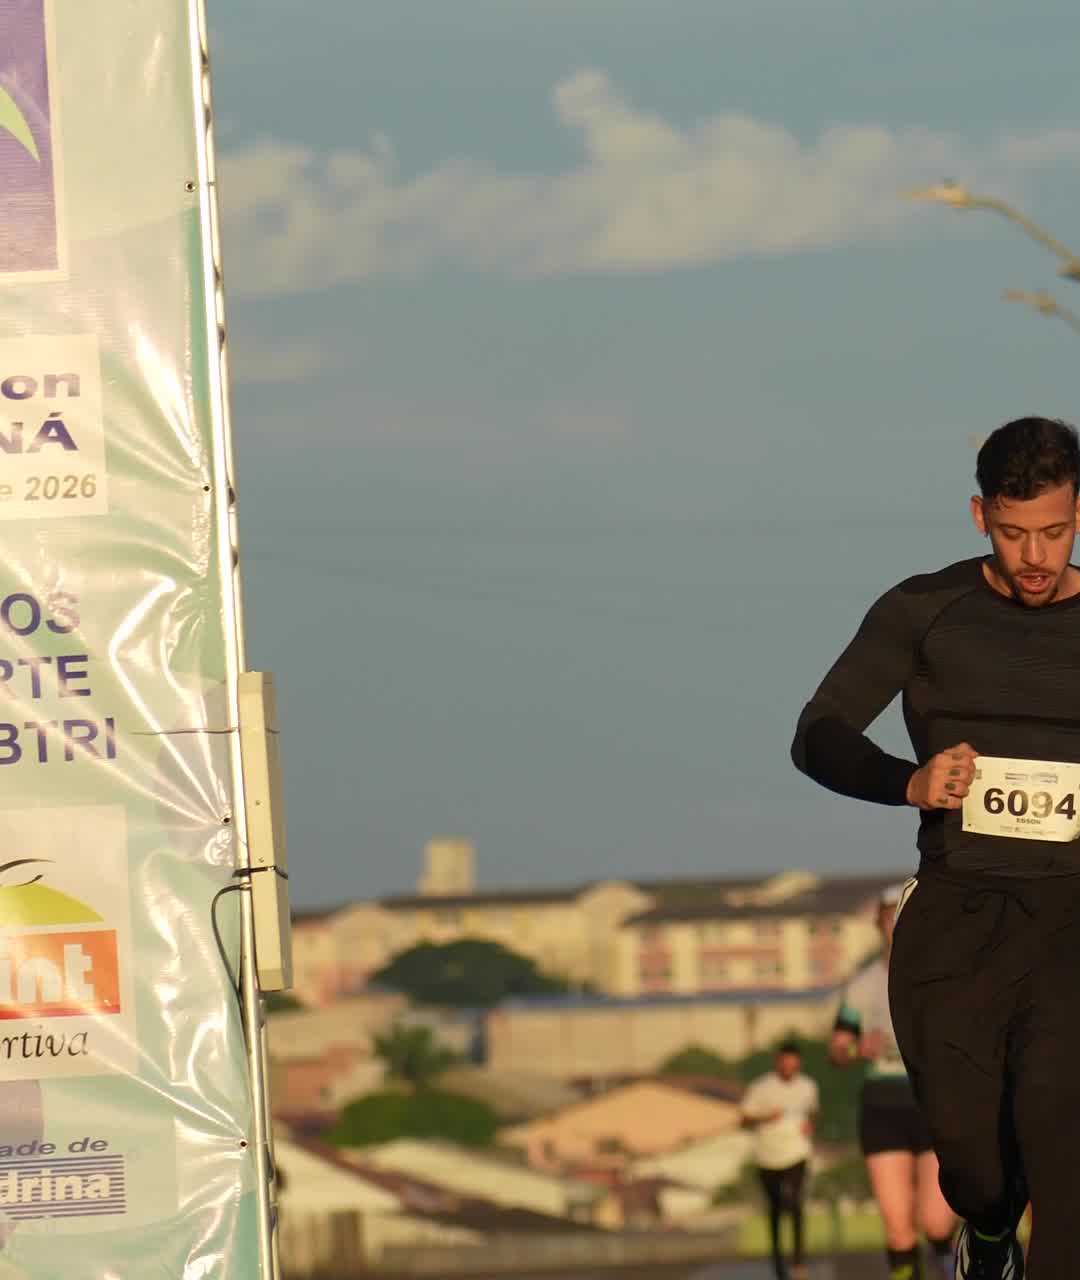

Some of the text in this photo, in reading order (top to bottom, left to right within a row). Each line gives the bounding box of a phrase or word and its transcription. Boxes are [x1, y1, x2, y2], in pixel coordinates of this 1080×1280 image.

[24, 473, 97, 501] 2026
[0, 592, 81, 636] OS
[983, 787, 1076, 820] 6094
[68, 1137, 109, 1153] de
